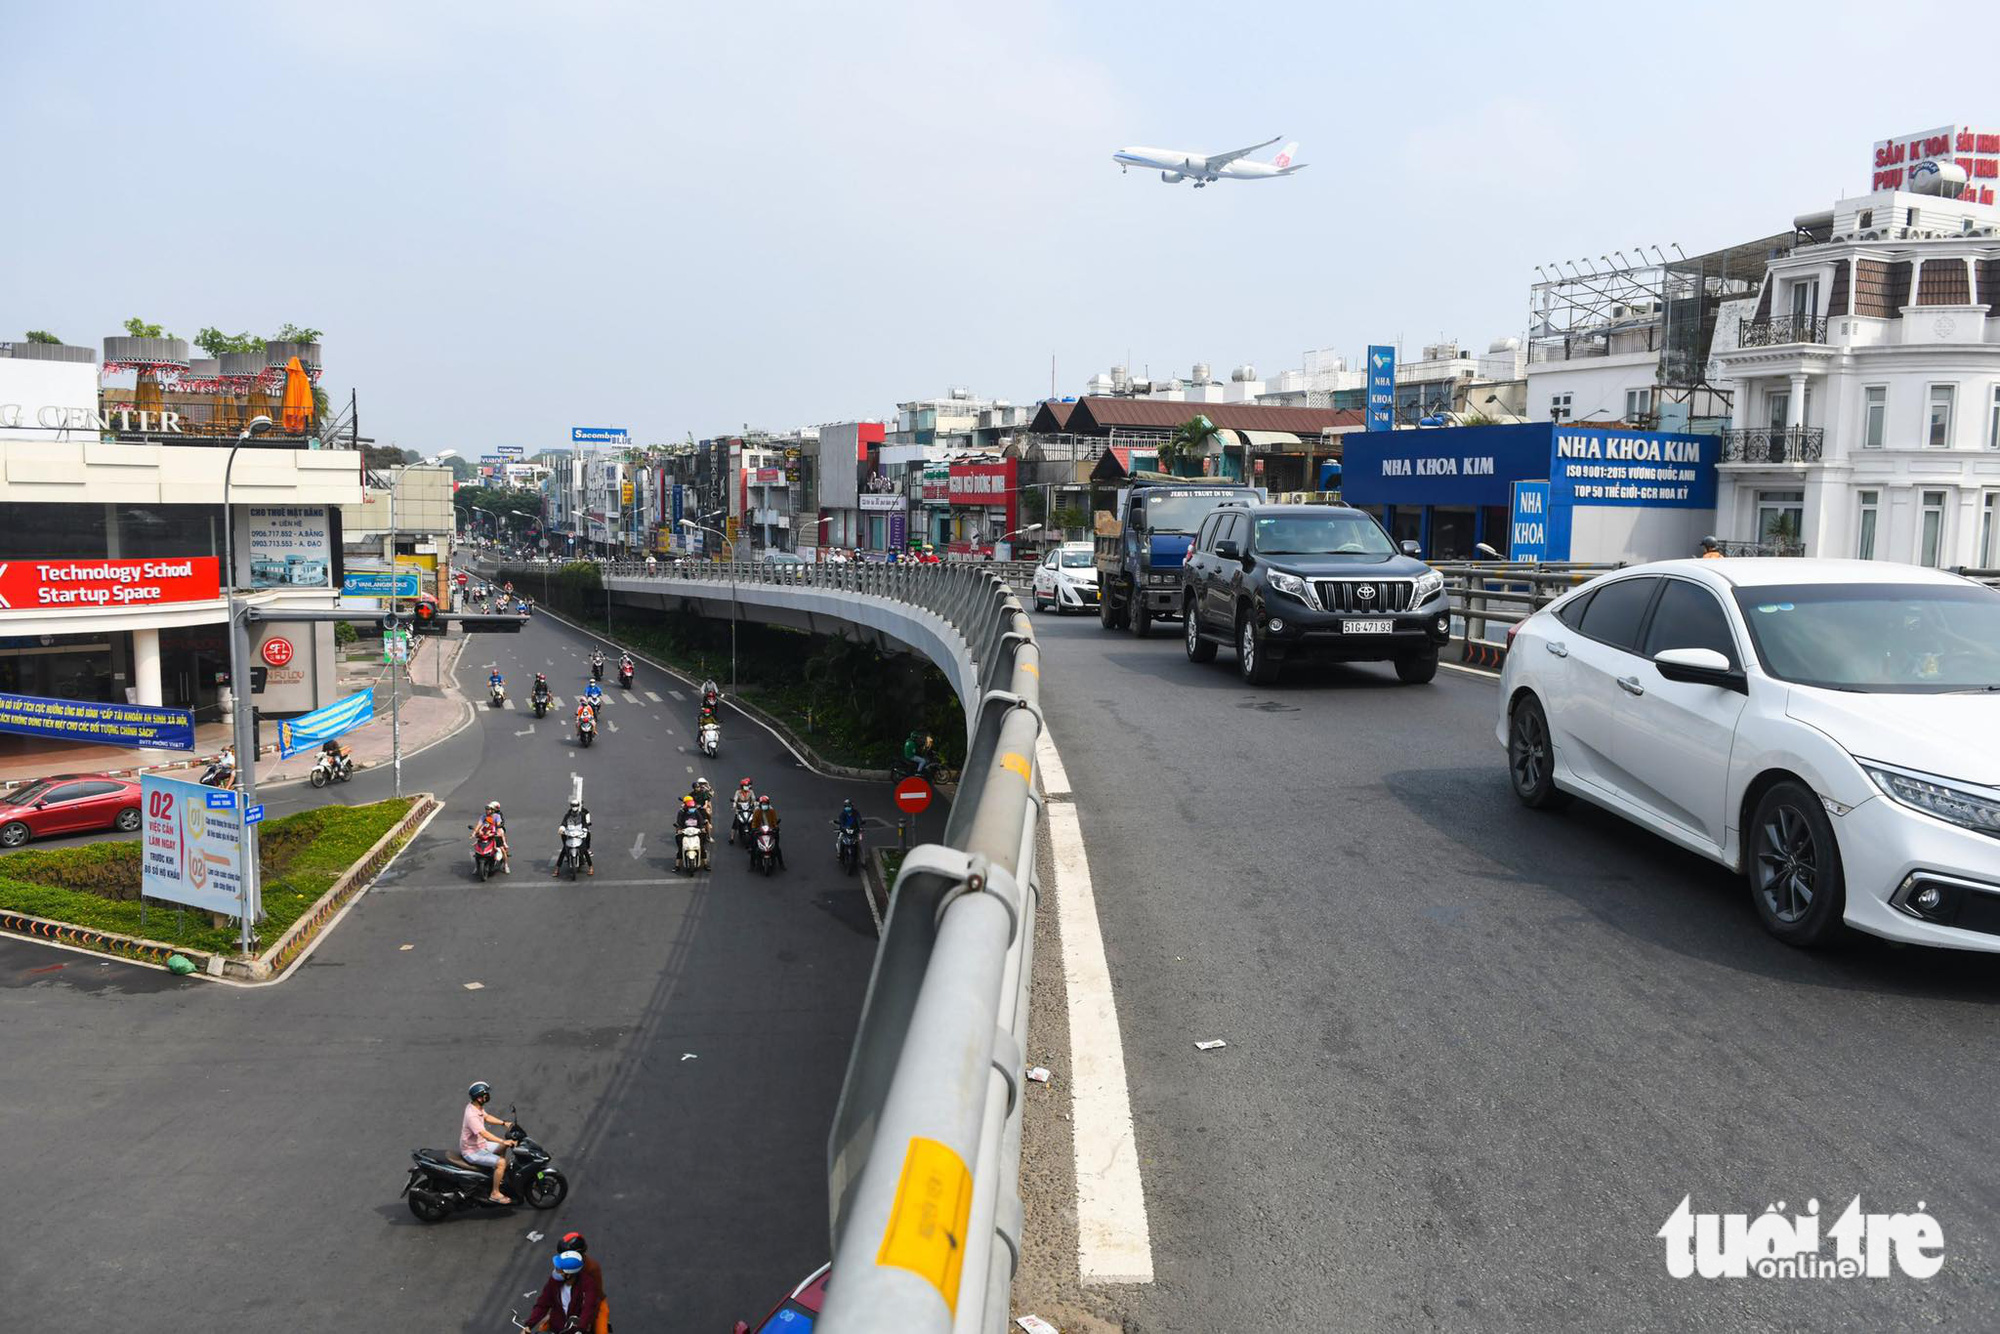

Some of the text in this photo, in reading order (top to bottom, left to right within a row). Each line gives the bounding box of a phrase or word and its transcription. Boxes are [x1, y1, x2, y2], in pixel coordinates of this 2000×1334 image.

[1875, 140, 1905, 168] SẢN
[1873, 168, 1903, 191] PHỤ
[1375, 377, 1391, 386] NHA
[1372, 394, 1392, 404] KHOA
[37, 406, 182, 433] CENTER
[1374, 412, 1389, 421] KIM
[575, 430, 625, 439] Sacombank
[1557, 436, 1700, 463] NHA KHOA KIM
[1382, 456, 1494, 476] NHA KHOA KIM
[1566, 463, 1696, 481] ISO 9001:2015 VƯƠNG QUỐC ANH
[1574, 485, 1591, 497] TOP
[1592, 486, 1603, 498] 50
[1605, 482, 1619, 499] THẾ
[250, 509, 266, 517] CHO
[267, 507, 286, 517] THUÊ
[1520, 492, 1542, 513] NHA
[1514, 523, 1544, 544] KHOA
[37, 561, 193, 583] Technology School
[38, 585, 160, 605] Startup Space
[149, 790, 174, 821] 02
[149, 836, 176, 850] LÀM NGAY
[193, 857, 202, 877] 02
